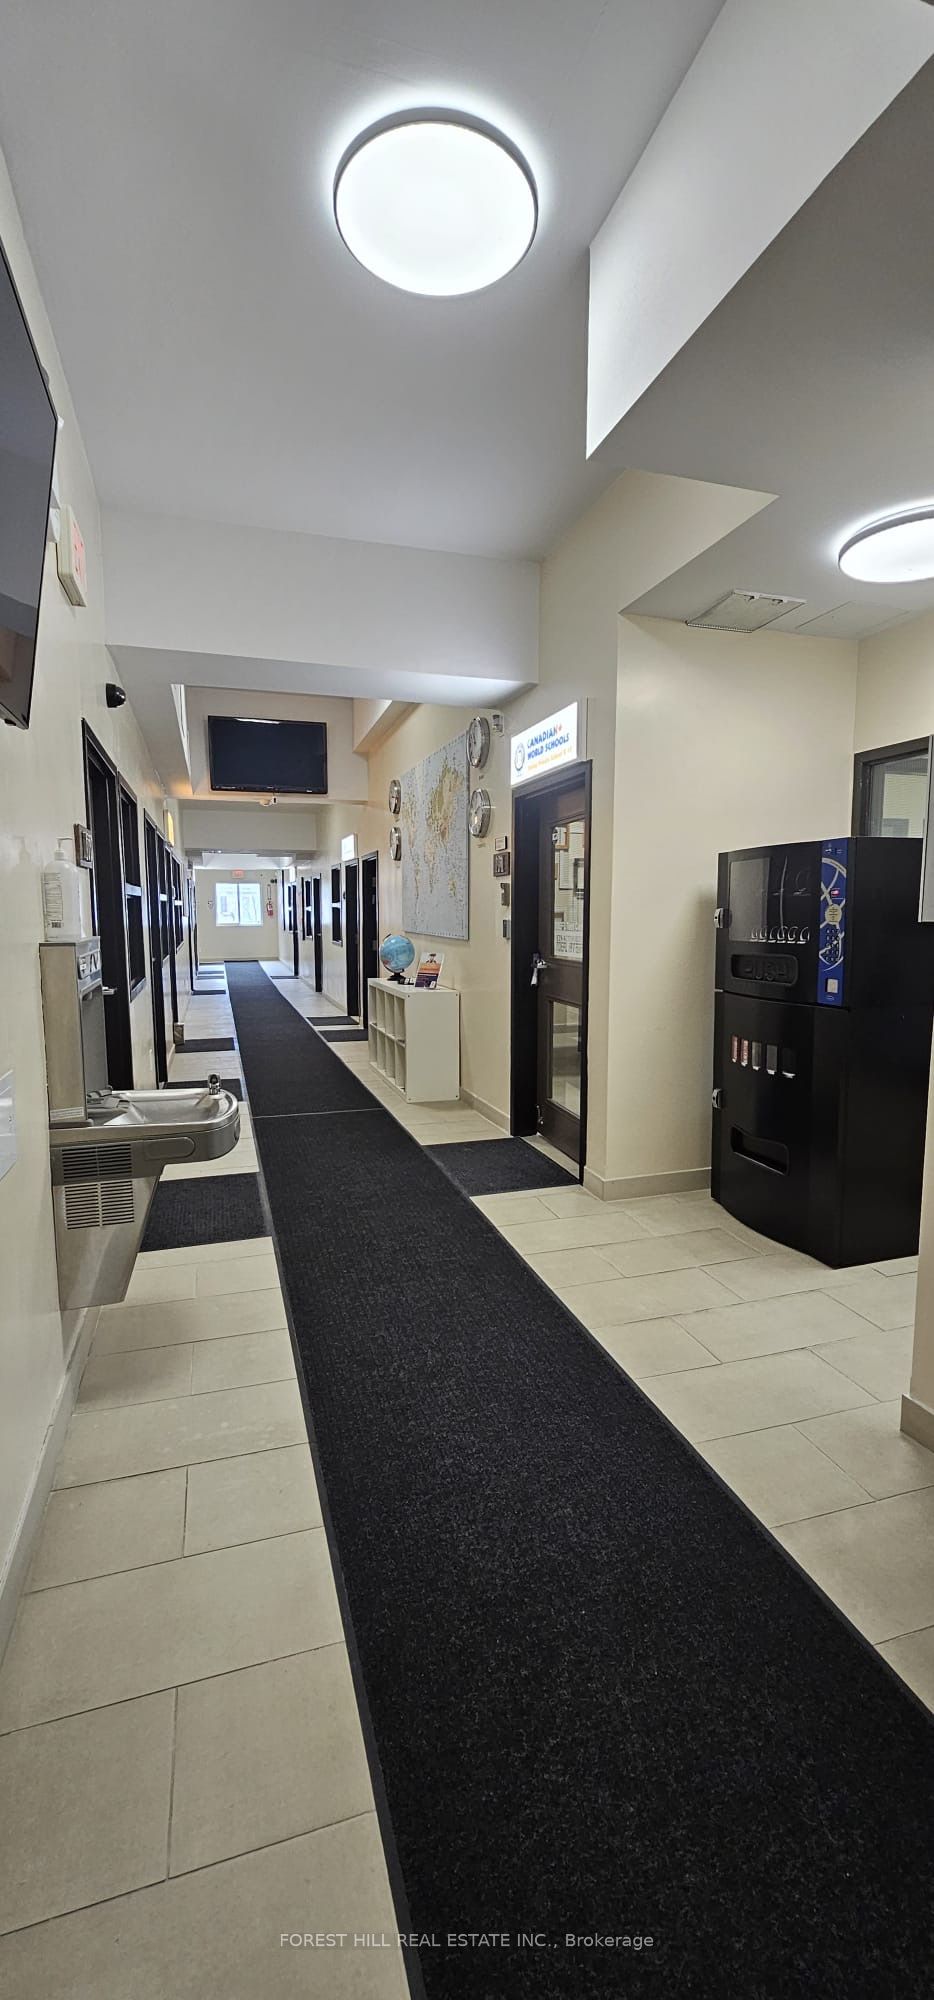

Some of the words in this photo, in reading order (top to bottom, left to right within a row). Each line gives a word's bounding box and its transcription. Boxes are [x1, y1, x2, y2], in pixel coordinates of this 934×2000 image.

[527, 725, 558, 749] CANADIAN
[527, 745, 544, 760] WORLD
[545, 732, 570, 752] SCHOOLS
